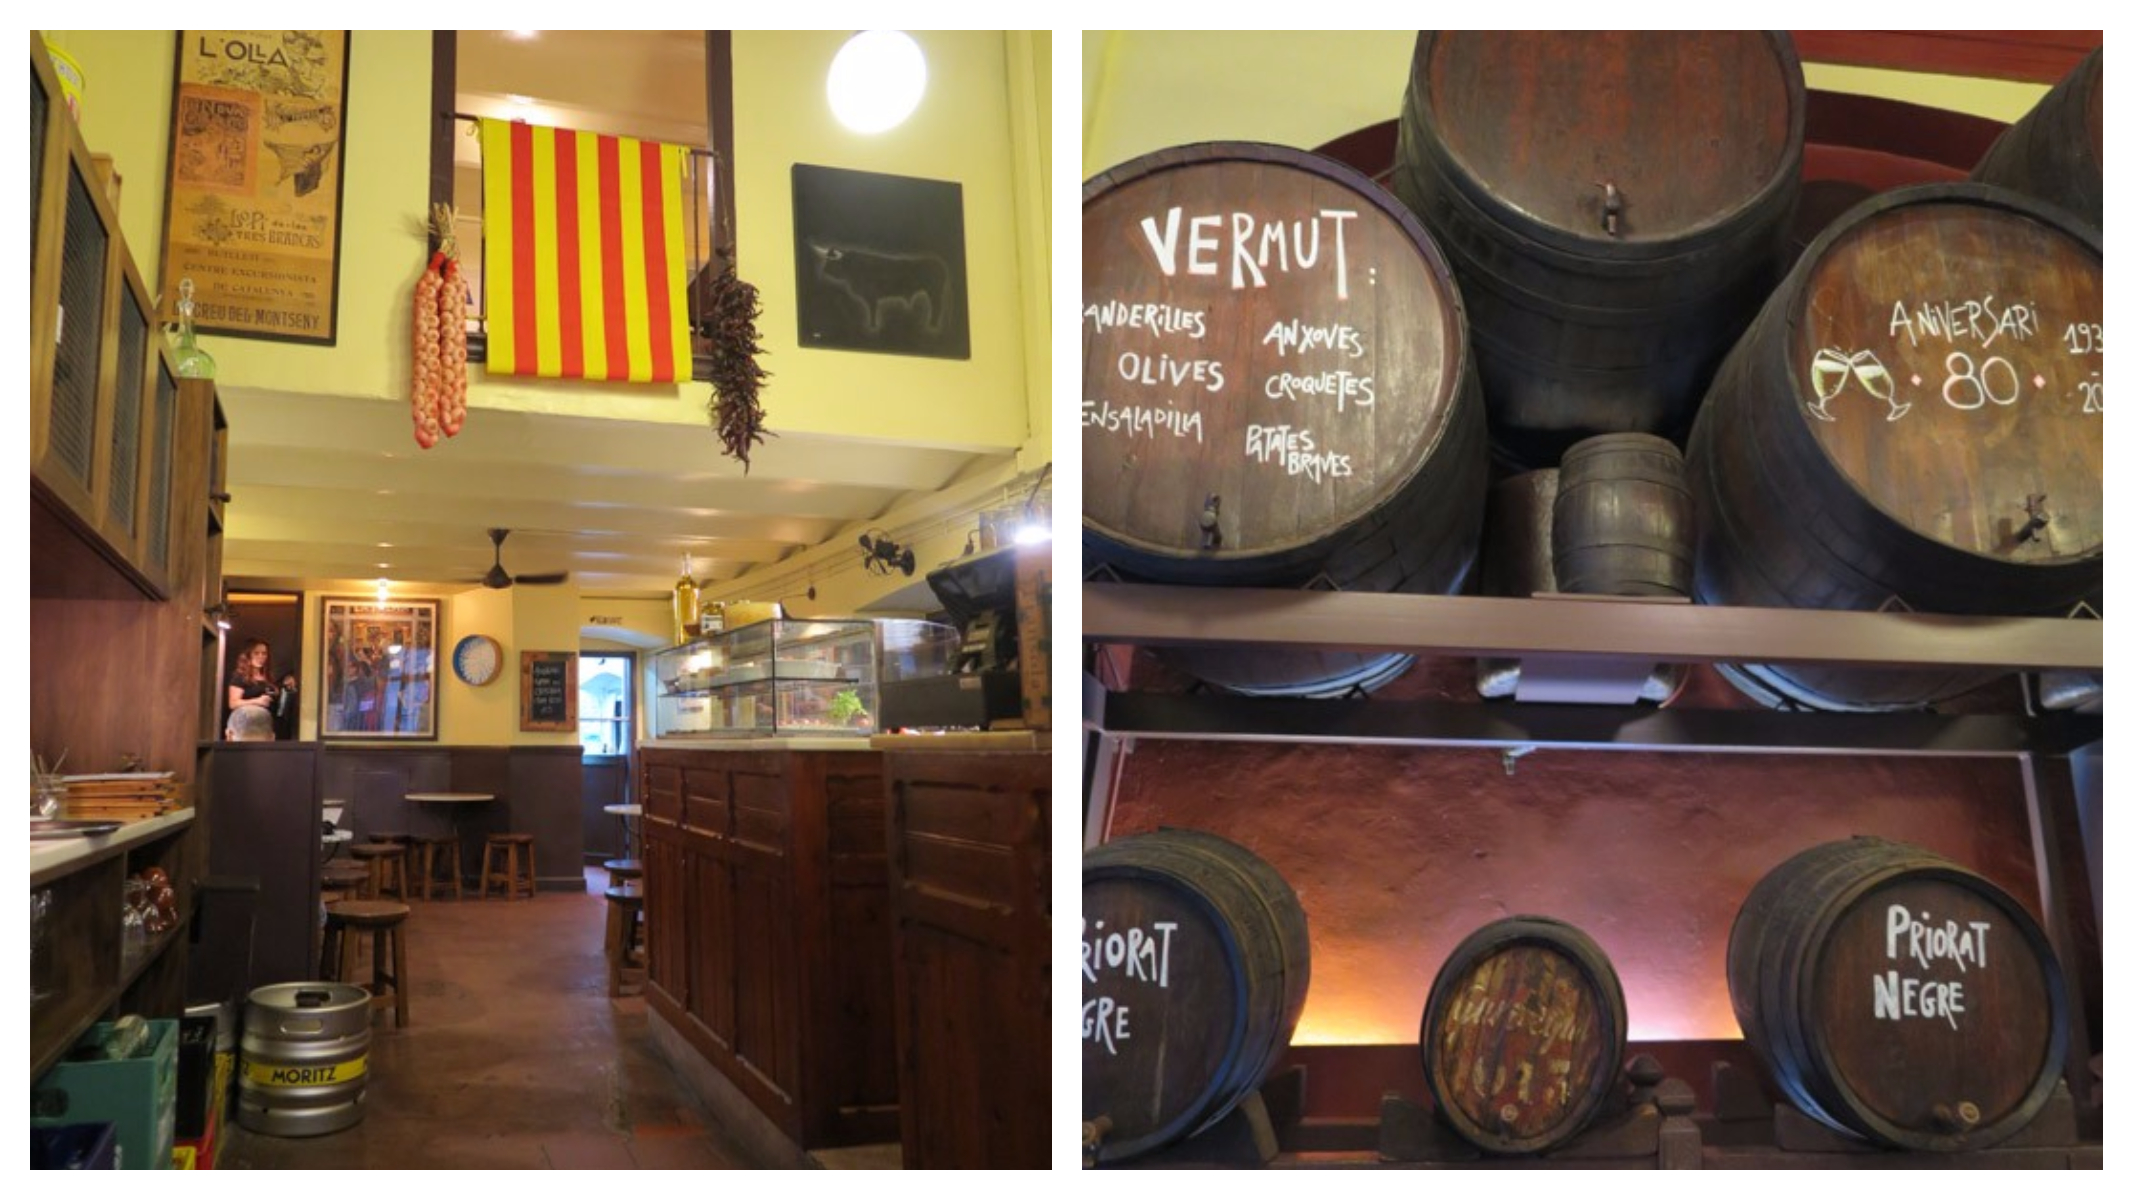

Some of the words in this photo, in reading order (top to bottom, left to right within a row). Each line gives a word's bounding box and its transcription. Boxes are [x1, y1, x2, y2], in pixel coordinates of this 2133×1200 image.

[200, 36, 289, 68] L'OLLA
[255, 308, 320, 330] MONTSENY
[1263, 318, 1364, 357] ANXOVES
[1265, 371, 1375, 413] CROQUETES
[1942, 351, 2019, 410] 80
[1246, 423, 1315, 467] PATATES
[1288, 450, 1352, 485] BRAVES
[1872, 970, 1966, 1031] NEGRE
[271, 1066, 337, 1084] MORITZ
